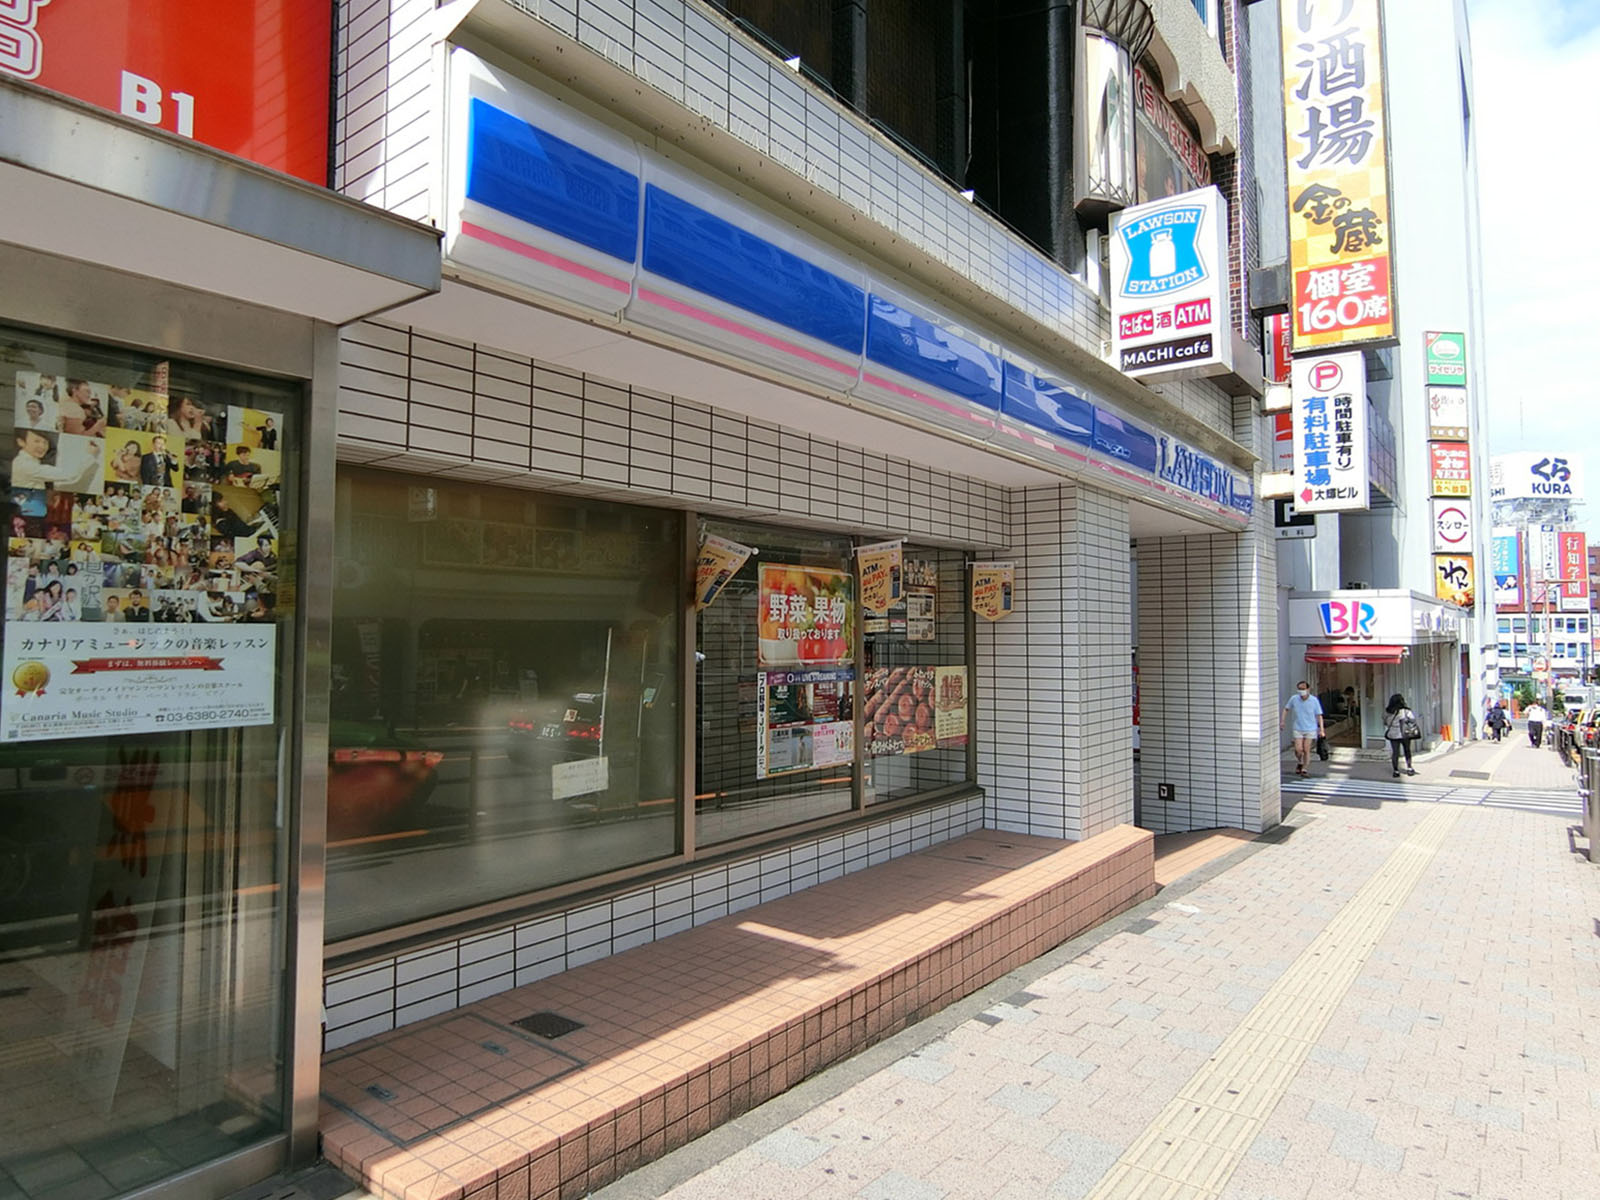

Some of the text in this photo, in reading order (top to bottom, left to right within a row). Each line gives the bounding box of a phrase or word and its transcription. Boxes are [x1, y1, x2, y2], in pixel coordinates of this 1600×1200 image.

[121, 70, 194, 138] B1
[1125, 210, 1199, 239] LAWSON
[1293, 183, 1383, 254] 金の蔵
[1128, 266, 1200, 292] STATION
[1305, 262, 1376, 301] 個室
[1120, 303, 1210, 336] たばこ 酒 ATM
[1298, 295, 1388, 332] 160席
[1123, 340, 1210, 366] MACHI café
[1315, 364, 1339, 388] P
[1303, 396, 1331, 486] 有料駐車場
[1159, 436, 1230, 506] LAWSON
[1531, 457, 1572, 482] くら
[1532, 482, 1573, 495] KURA
[1436, 520, 1469, 530] スシロー
[1320, 601, 1376, 634] BR
[21, 638, 269, 651] カナリアミュージックの音楽レッスン
[777, 627, 841, 641] 取り扱っております
[22, 707, 138, 722] Canaria Music Studio
[166, 708, 250, 722] 03-6380-2740
